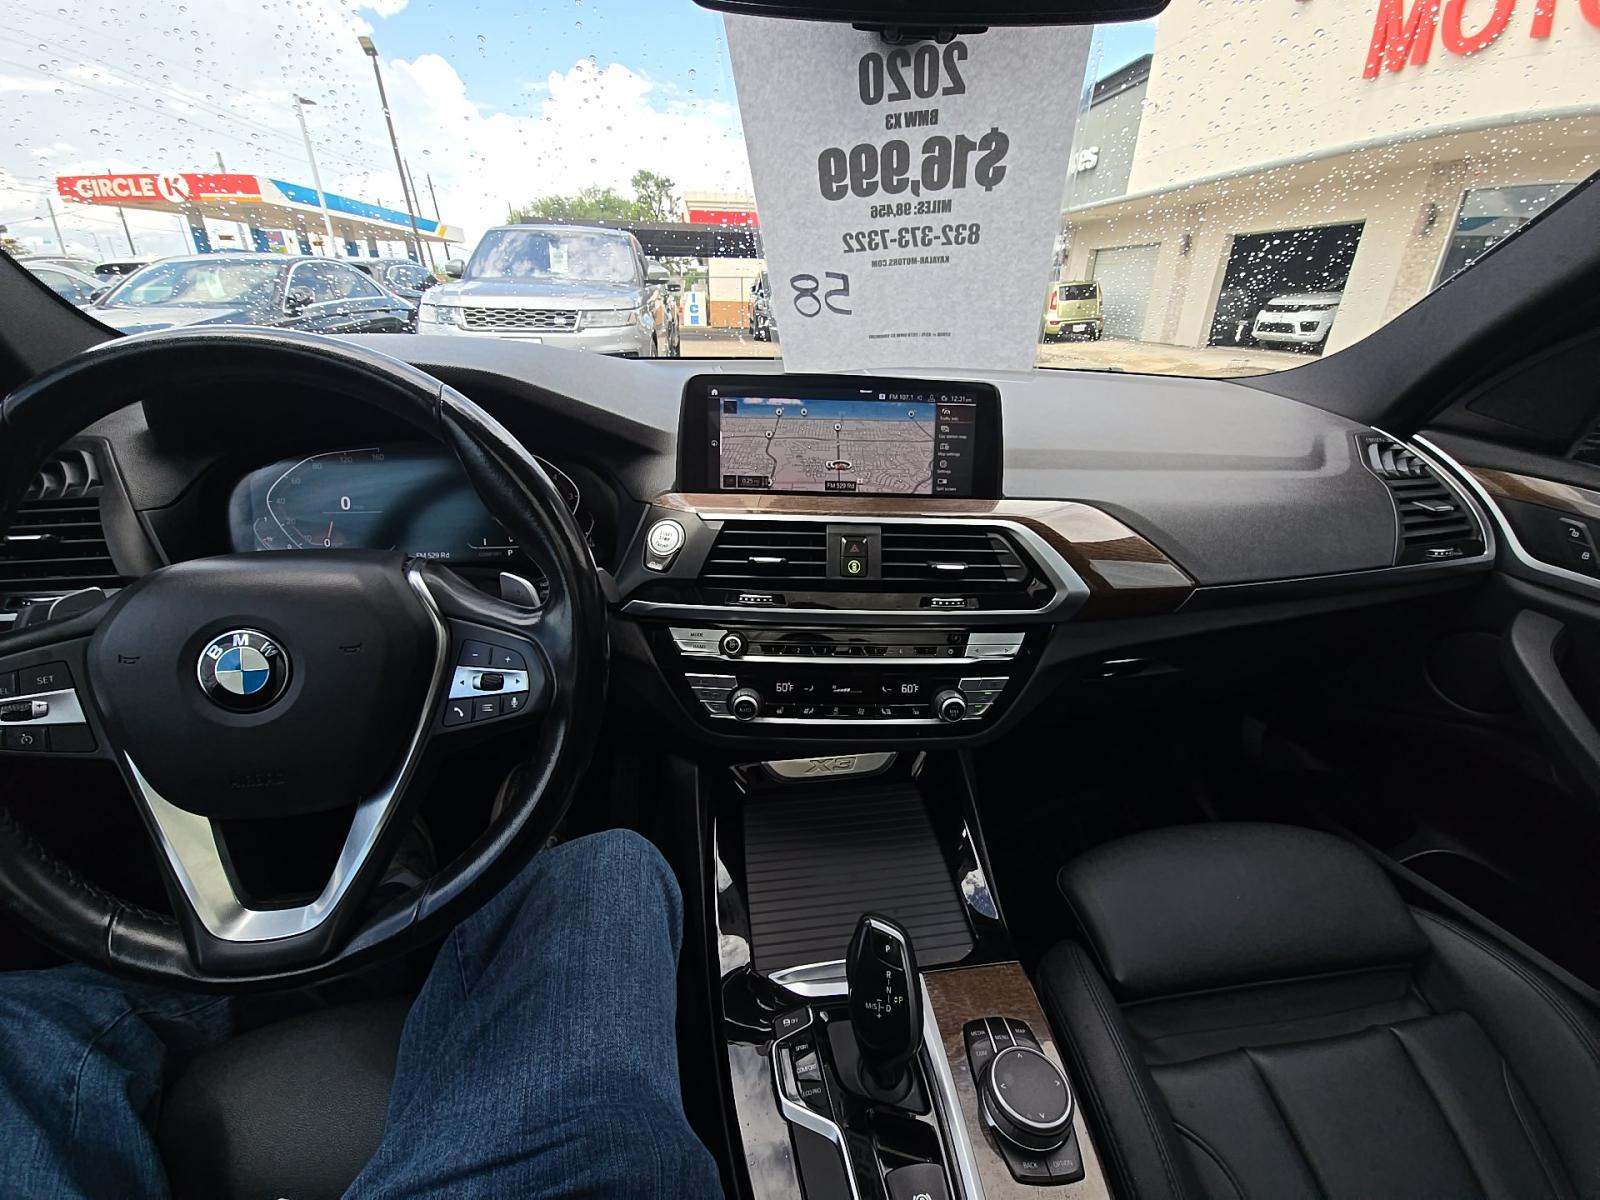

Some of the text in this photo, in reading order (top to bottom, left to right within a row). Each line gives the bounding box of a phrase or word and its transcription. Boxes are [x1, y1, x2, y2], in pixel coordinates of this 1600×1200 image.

[1362, 0, 1600, 79] MO
[75, 174, 191, 201] CIRCLE K
[340, 496, 351, 510] 0
[324, 539, 331, 547] 0
[206, 633, 279, 660] BMW
[36, 674, 55, 685] SET
[885, 944, 891, 953] P
[886, 970, 892, 979] R
[886, 986, 892, 994] N
